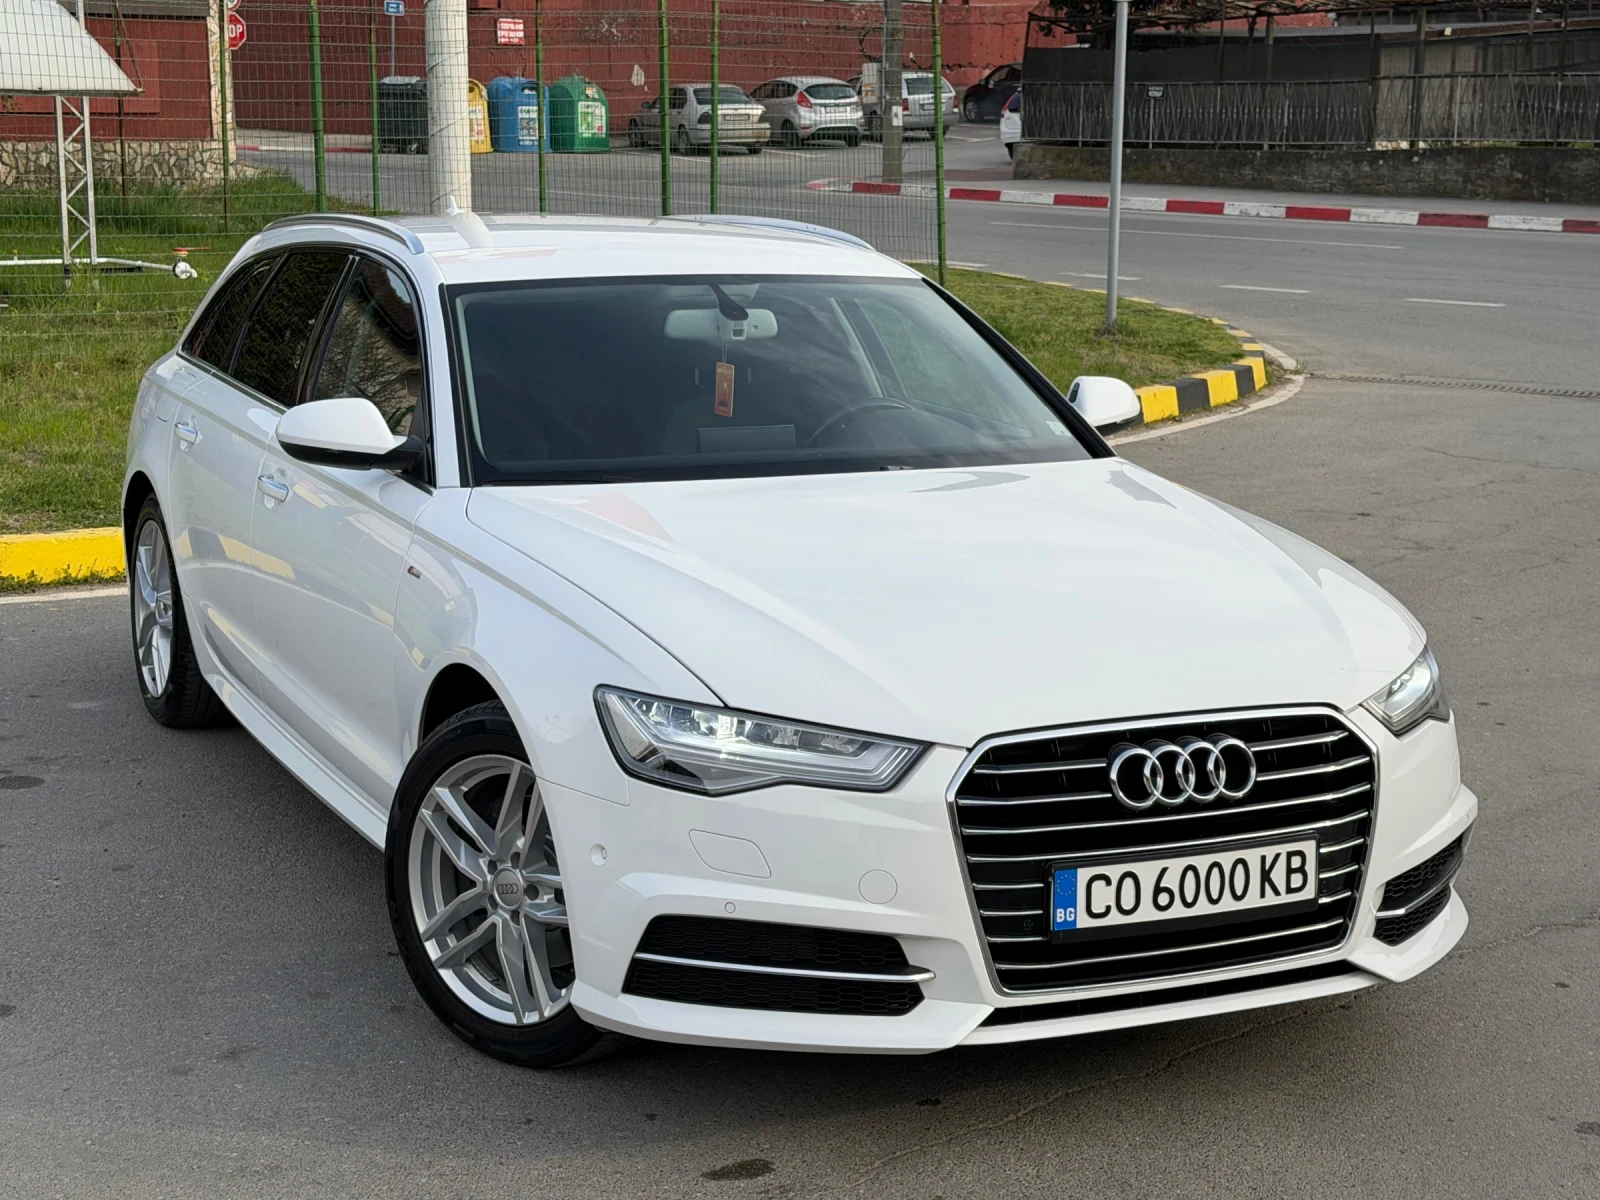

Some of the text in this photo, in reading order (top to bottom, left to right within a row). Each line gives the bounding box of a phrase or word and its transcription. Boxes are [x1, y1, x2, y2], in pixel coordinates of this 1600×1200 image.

[229, 24, 243, 38] OP
[1085, 848, 1309, 920] CO 6000 KB
[1056, 907, 1075, 923] BG
